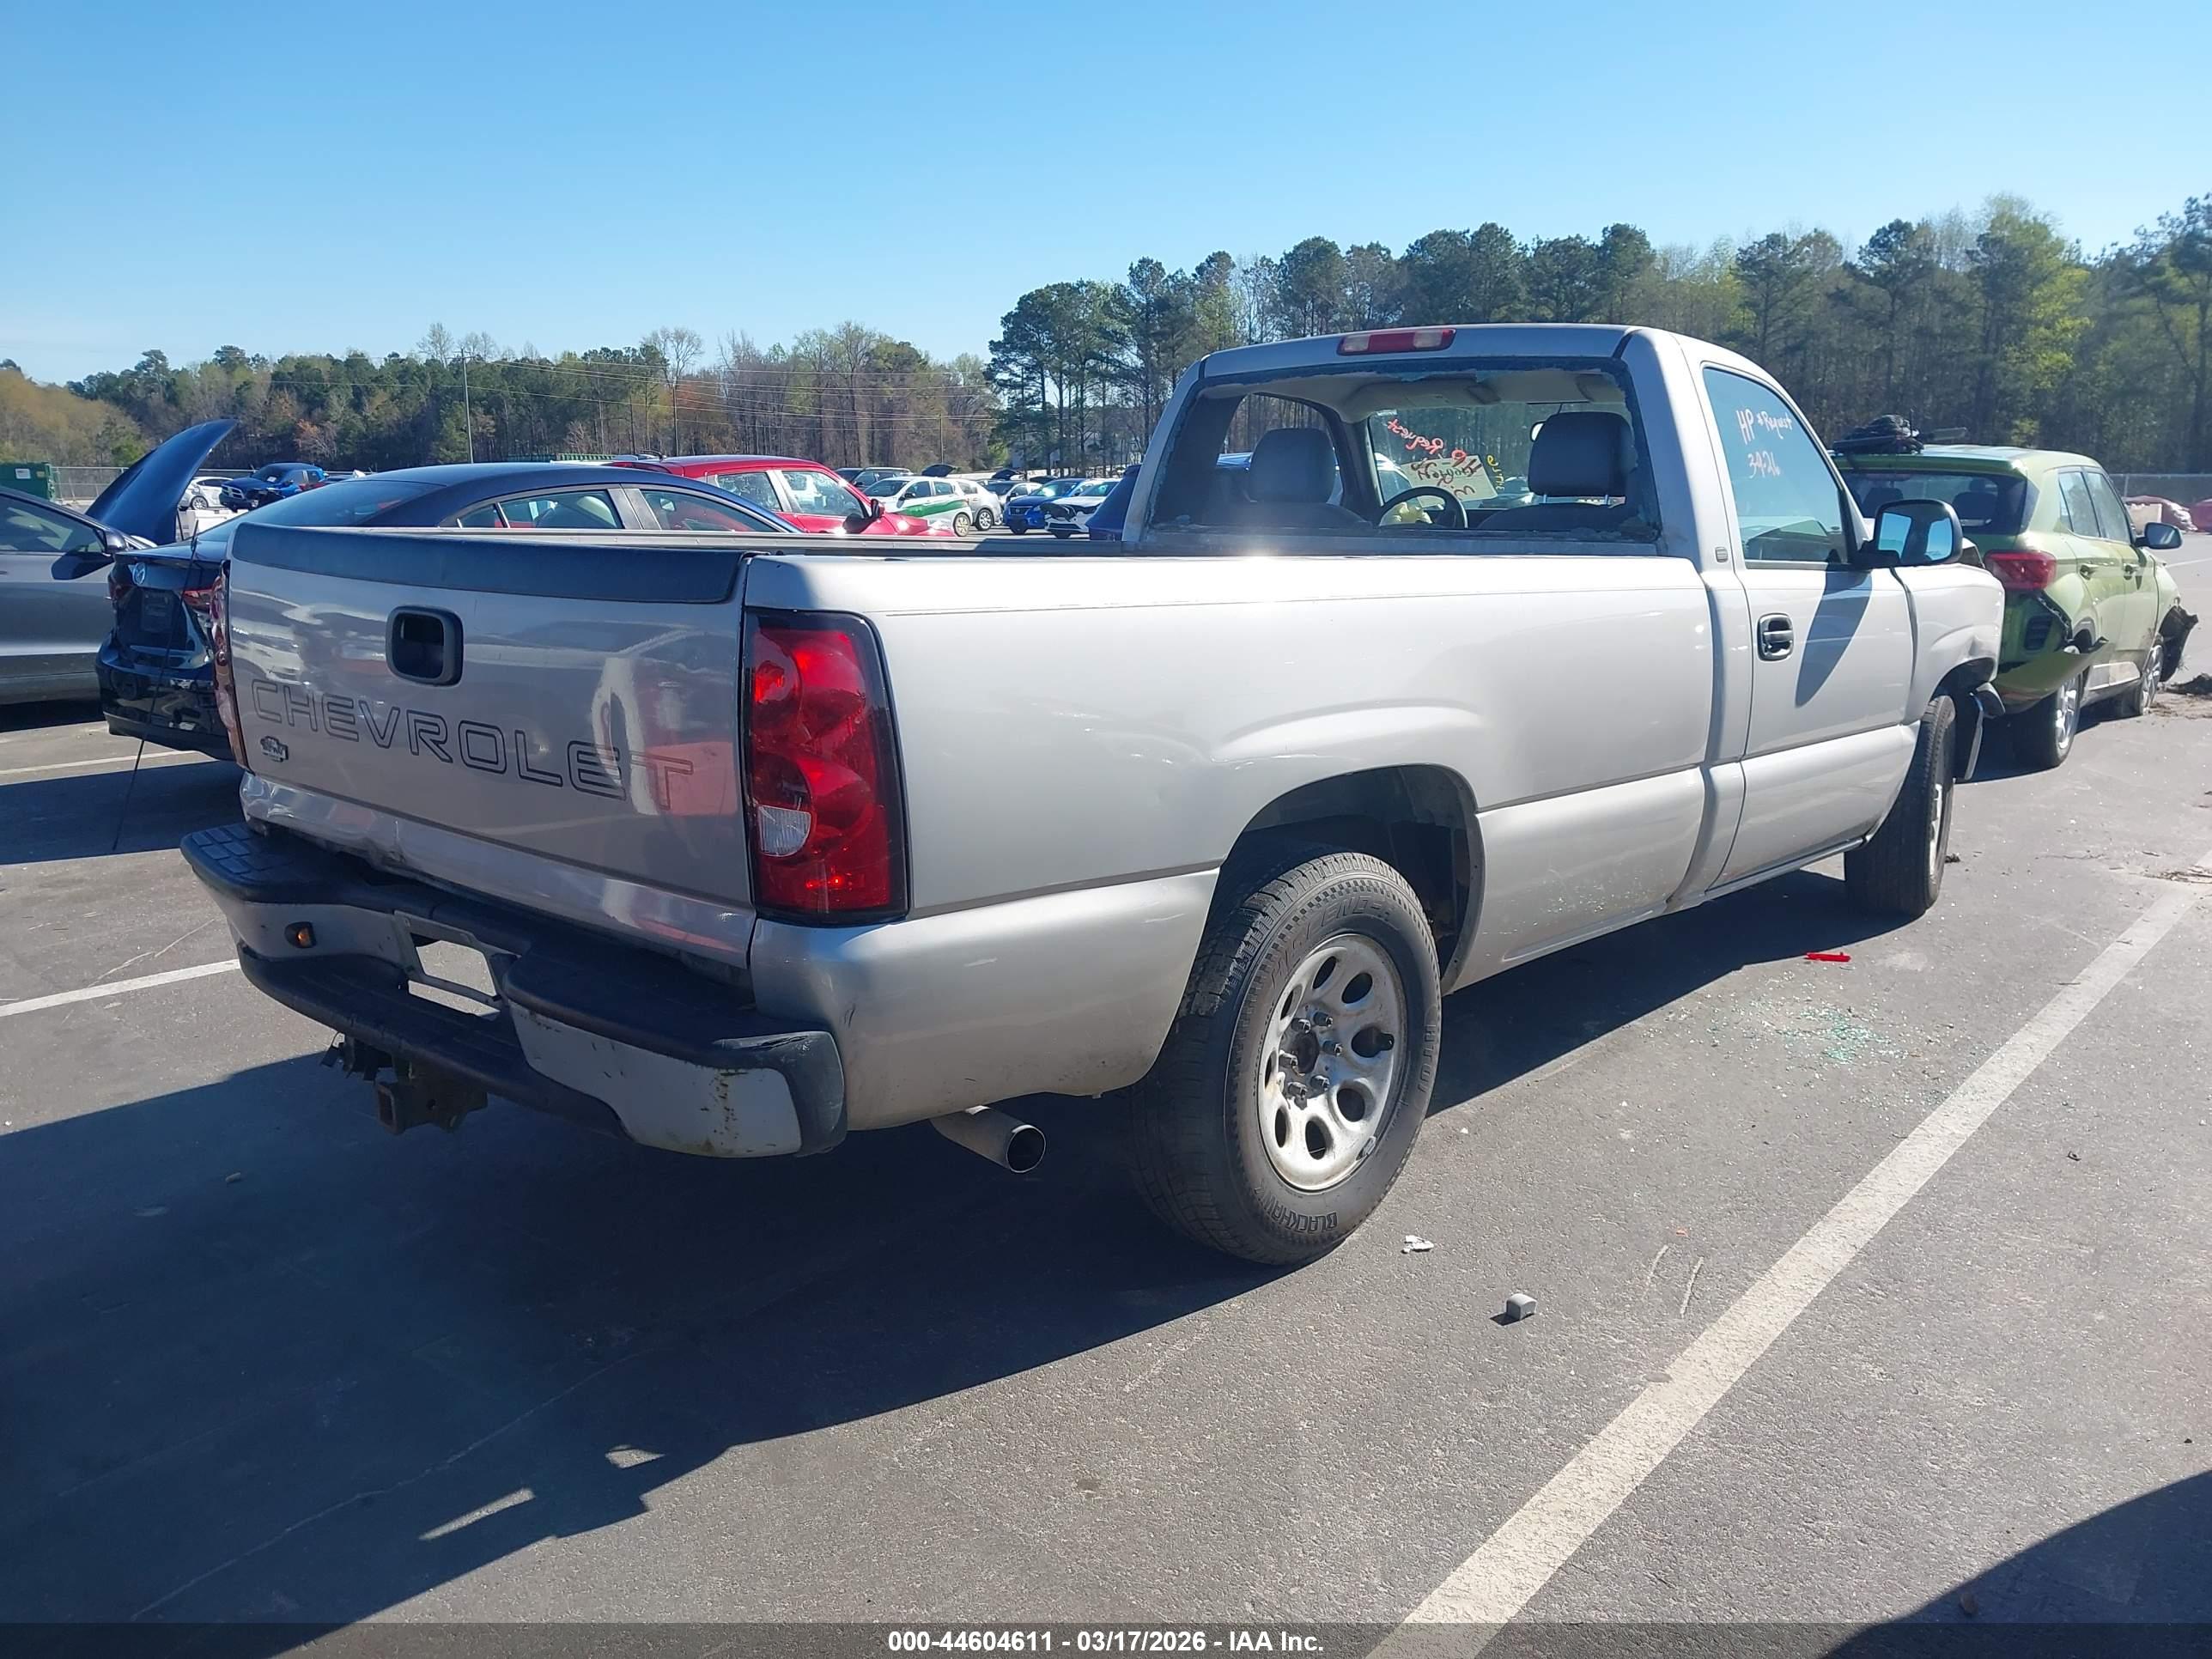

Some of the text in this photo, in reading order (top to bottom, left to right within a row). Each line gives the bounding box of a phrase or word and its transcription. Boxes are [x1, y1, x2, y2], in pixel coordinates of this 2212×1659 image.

[1735, 409, 1755, 445] HP
[252, 678, 694, 811] CHEVROLET
[1254, 1180, 1338, 1234] BLACKHAWK
